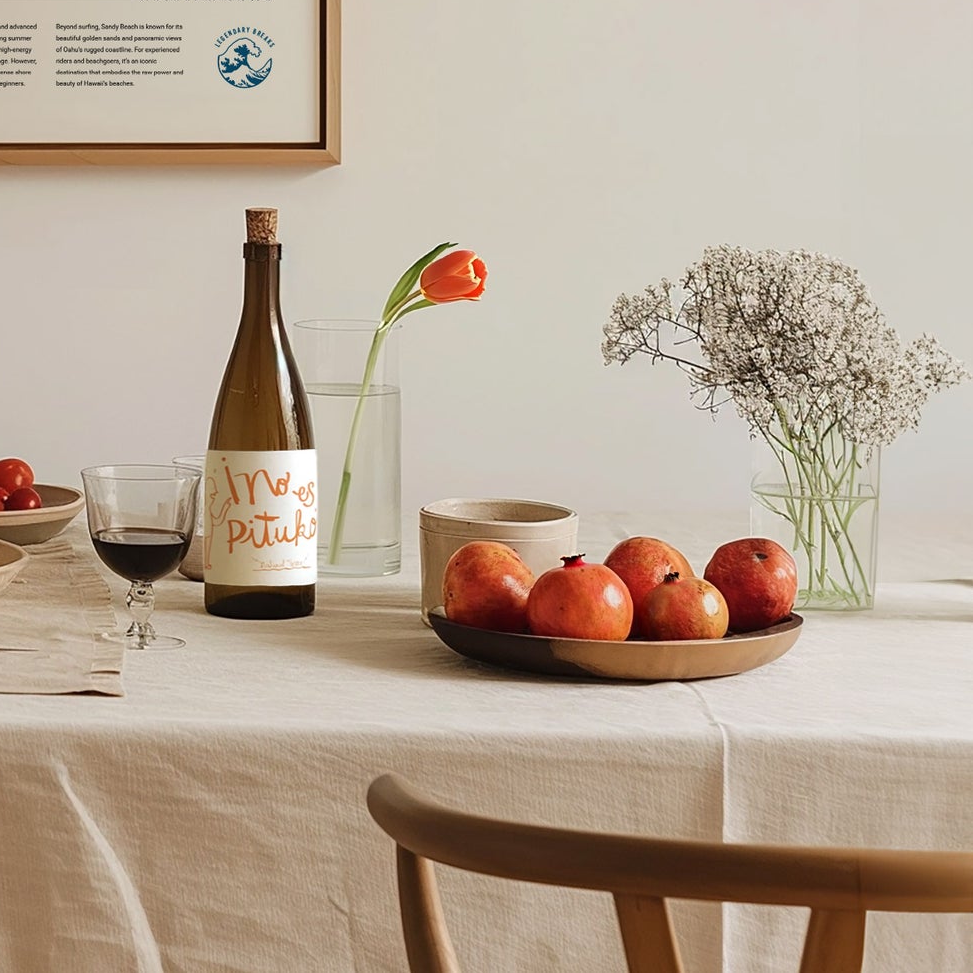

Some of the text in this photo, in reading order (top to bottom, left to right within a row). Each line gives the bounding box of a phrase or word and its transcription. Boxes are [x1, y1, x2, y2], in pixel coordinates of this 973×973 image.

[10, 22, 37, 31] advanced
[56, 22, 77, 32] Beyond
[101, 22, 119, 32] Sandy
[120, 22, 138, 31] Beach
[56, 34, 81, 42] beautiful
[82, 34, 102, 43] golden
[103, 34, 120, 42] sands
[122, 34, 133, 42] and
[214, 26, 276, 48] LEGENDARY BREAKS
[0, 46, 32, 55] high-energy
[84, 45, 104, 55] rugged
[134, 45, 144, 53] For
[145, 46, 180, 55] experienced
[56, 57, 72, 65] riders
[74, 57, 85, 65] and
[56, 79, 75, 89] beauty
